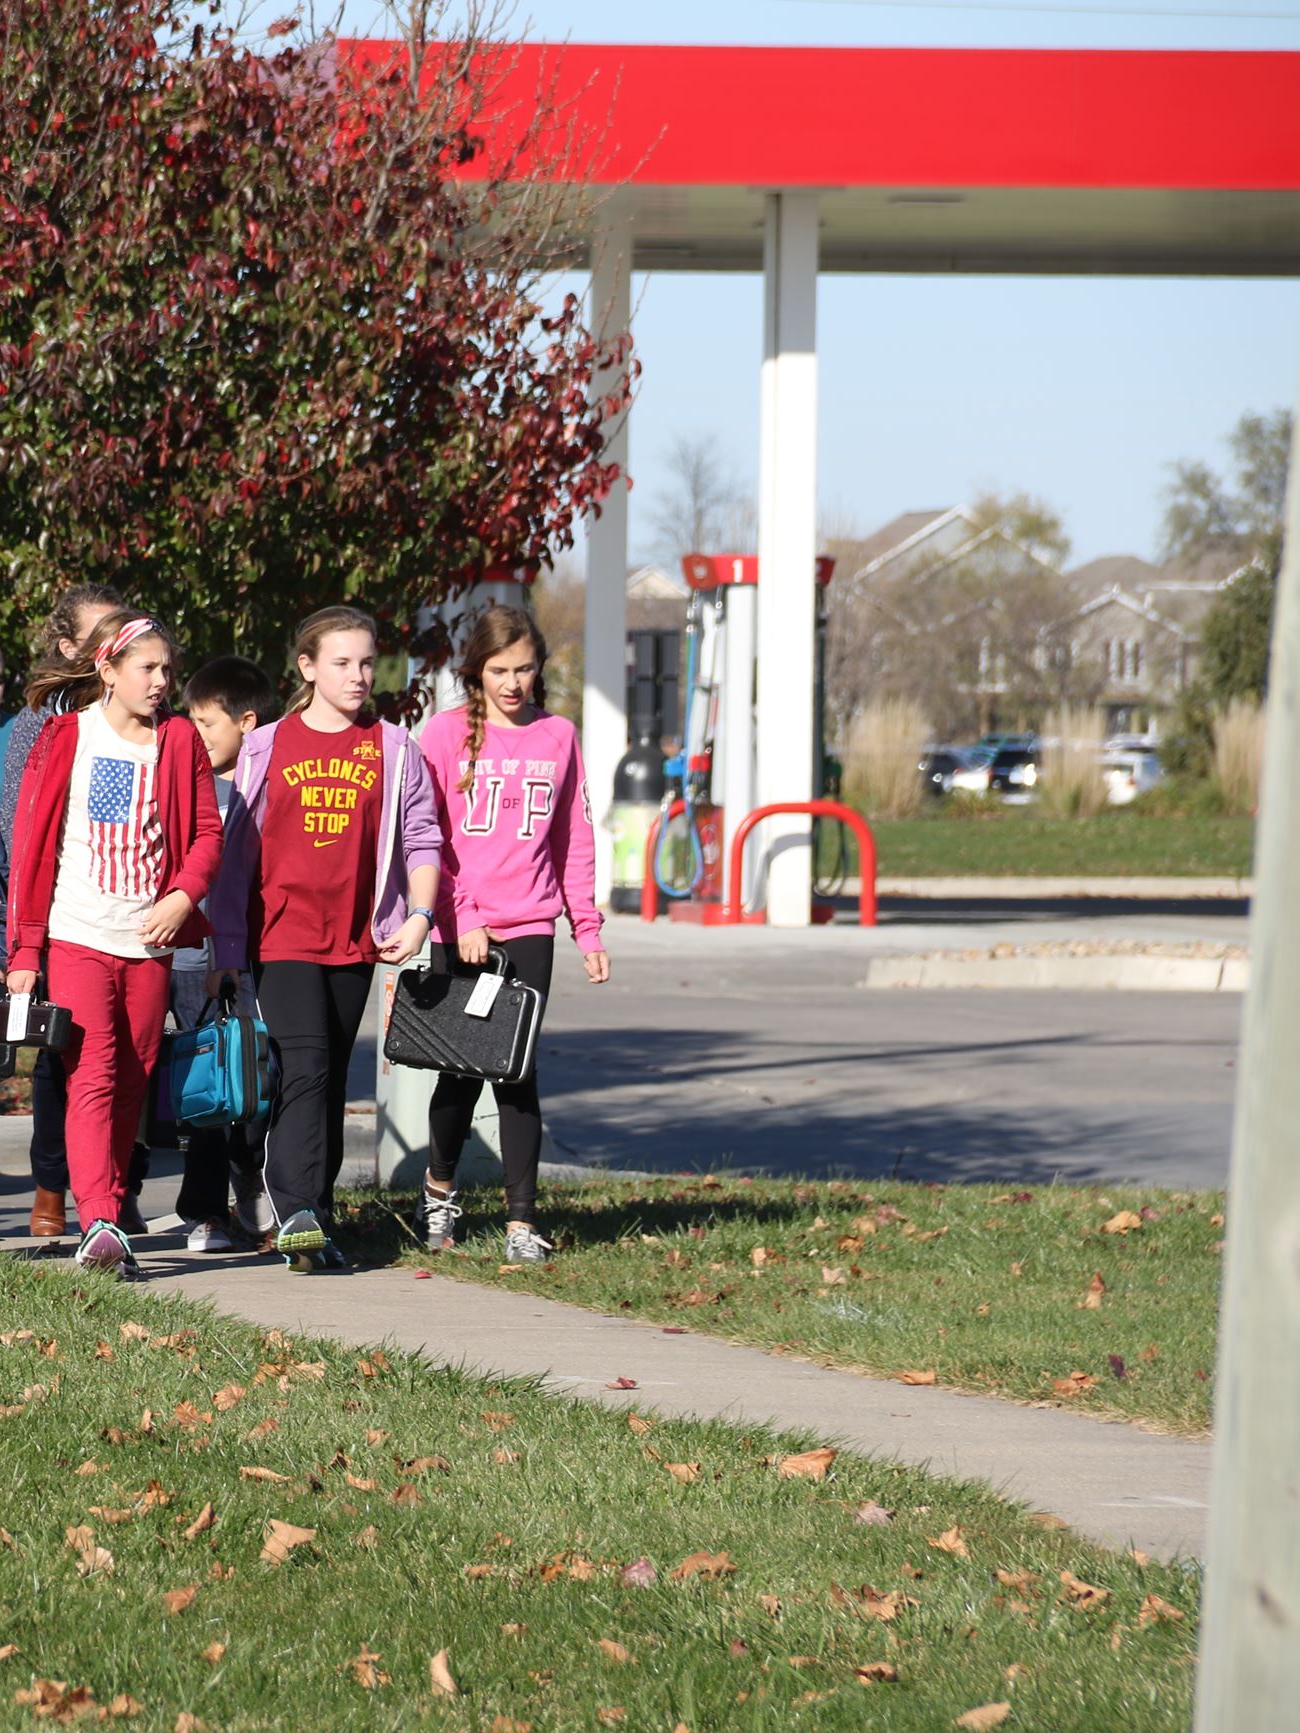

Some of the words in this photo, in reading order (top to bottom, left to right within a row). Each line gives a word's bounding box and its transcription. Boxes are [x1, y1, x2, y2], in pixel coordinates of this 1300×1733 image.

[732, 558, 744, 583] 1
[282, 758, 377, 790] CYCLONES
[301, 786, 357, 809] NEVER
[502, 798, 520, 809] OF
[517, 778, 554, 840] P
[304, 812, 349, 834] STOP
